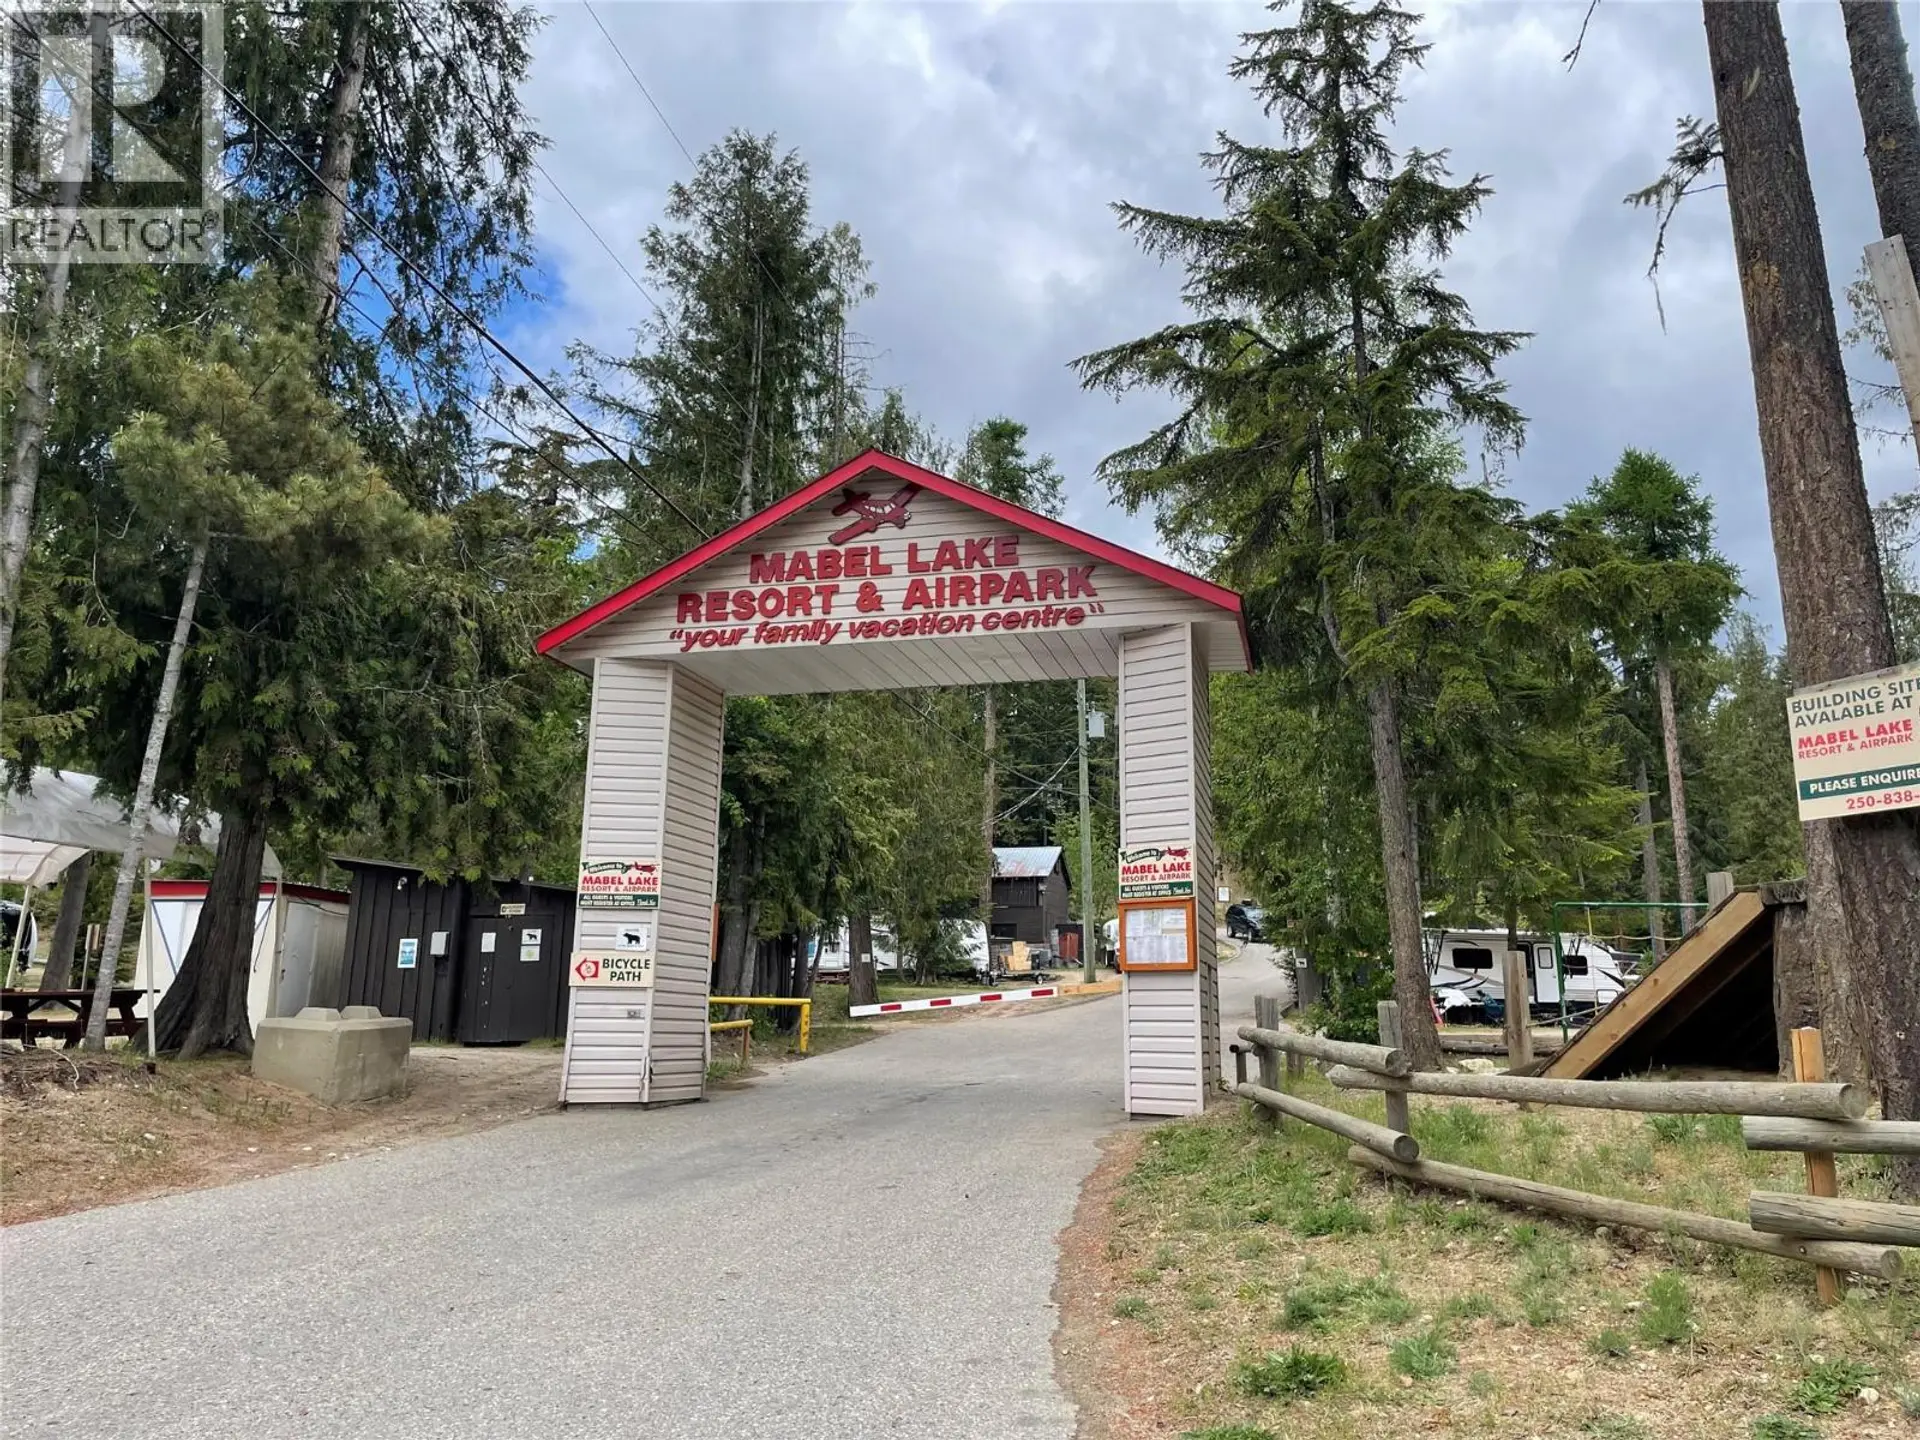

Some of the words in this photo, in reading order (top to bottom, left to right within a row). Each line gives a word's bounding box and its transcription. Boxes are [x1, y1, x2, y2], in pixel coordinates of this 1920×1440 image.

[750, 546, 892, 584] MABEL
[907, 535, 1020, 573] LAKE
[677, 584, 839, 623] RESORT
[856, 582, 885, 613] &
[902, 565, 1098, 610] AIRPARK
[754, 619, 842, 645] family
[849, 614, 978, 639] vacation
[1792, 686, 1881, 714] BUILDING
[1795, 701, 1885, 728] AVALABLE
[1891, 695, 1913, 711] AT
[1798, 729, 1859, 749] MABEL
[1865, 719, 1913, 738] LAKE
[1798, 744, 1842, 760] RESORT
[1847, 743, 1855, 752] &
[1860, 732, 1914, 750] AIRPARK
[1810, 777, 1857, 794] PLEASE
[582, 876, 623, 885] MABEL
[628, 877, 658, 885] LAKE
[1122, 864, 1159, 875] MABEL
[1163, 862, 1191, 873] LAKE
[1122, 875, 1148, 883] RESORT
[1159, 873, 1191, 881] AIRPARK
[602, 959, 650, 970] BICYCLE
[610, 971, 641, 982] PATH
